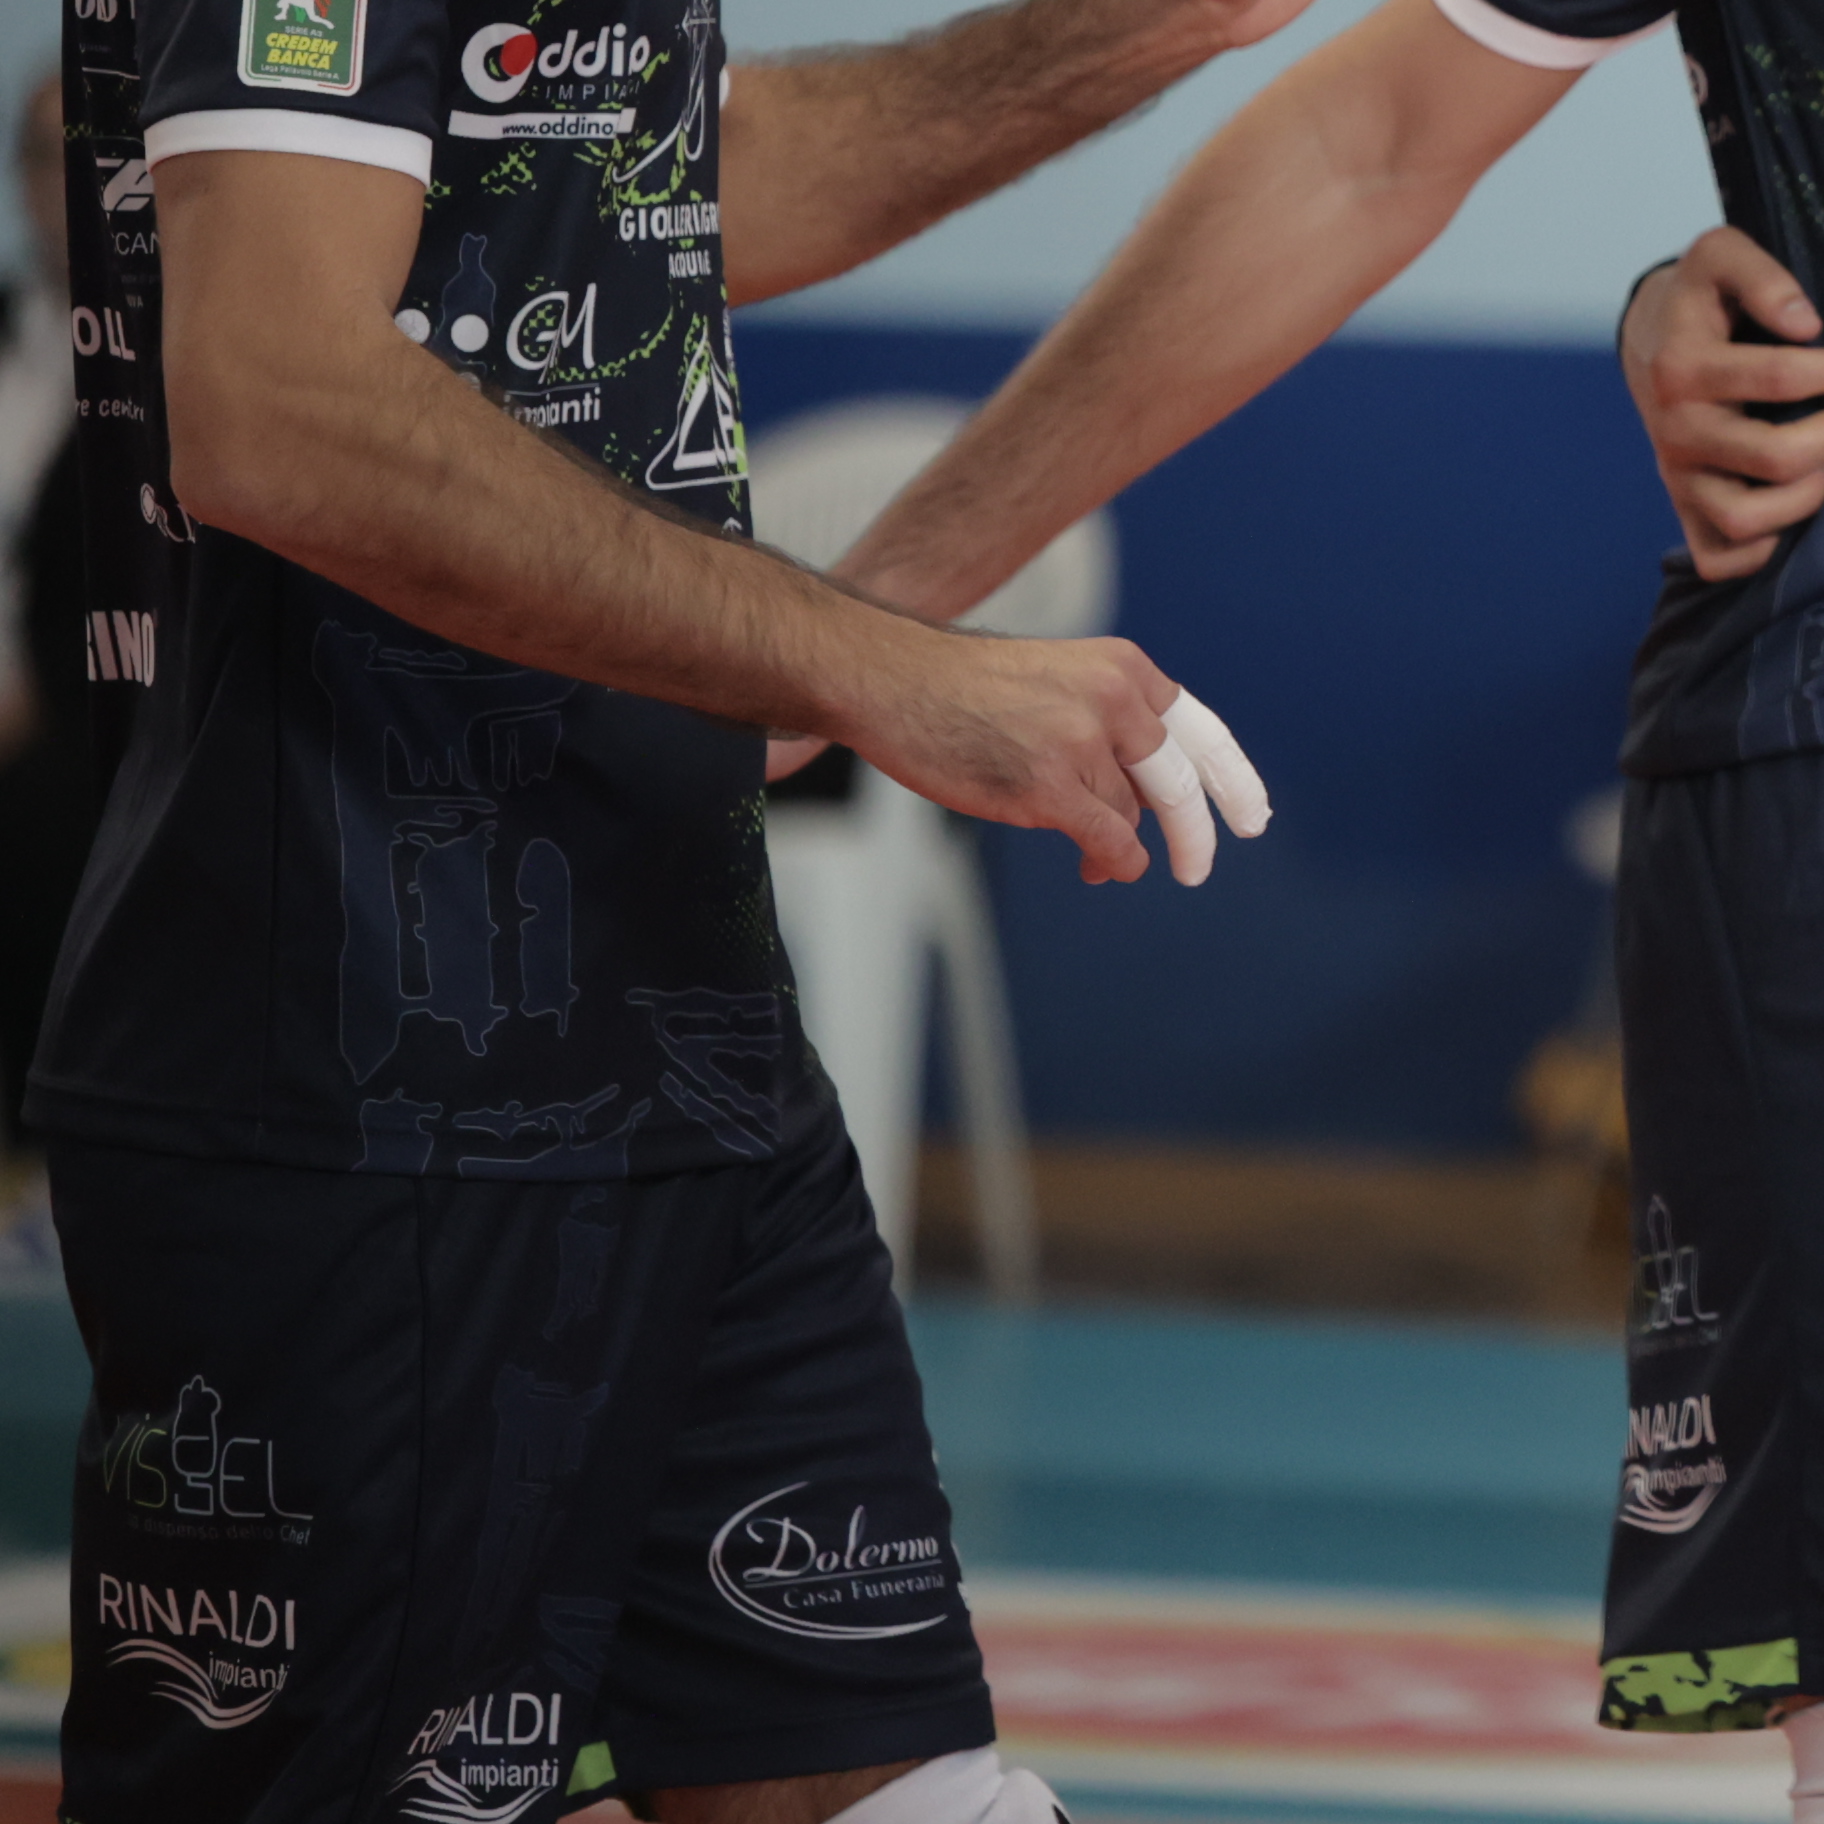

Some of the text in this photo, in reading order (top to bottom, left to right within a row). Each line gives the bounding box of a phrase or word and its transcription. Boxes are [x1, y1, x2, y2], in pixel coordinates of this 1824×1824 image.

[266, 32, 338, 55] CREDEM
[266, 48, 332, 70] BANCA
[783, 1588, 843, 1609] Casa
[100, 1572, 296, 1651] RINALDI
[461, 1758, 560, 1794] impianti
